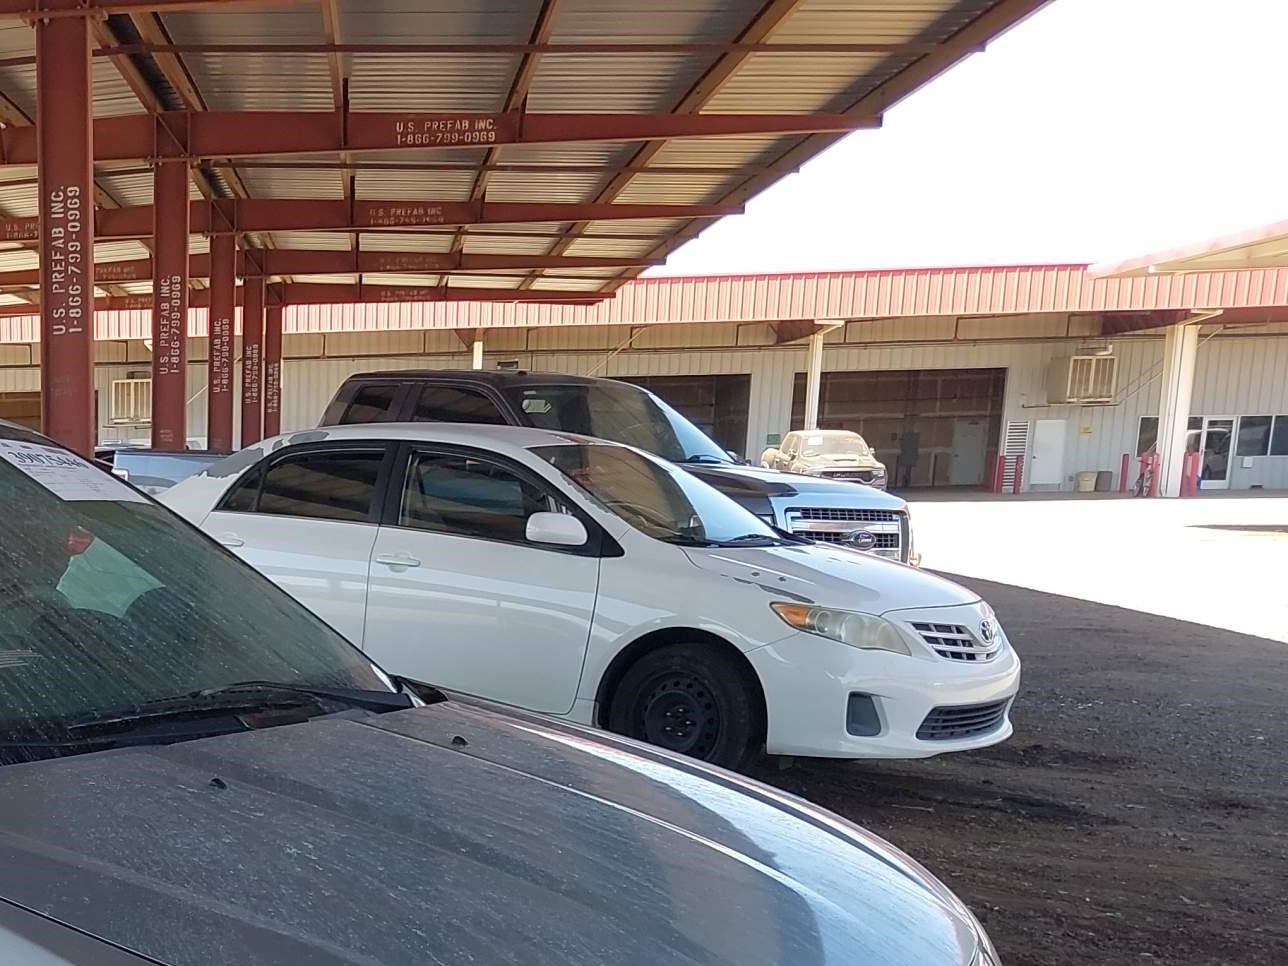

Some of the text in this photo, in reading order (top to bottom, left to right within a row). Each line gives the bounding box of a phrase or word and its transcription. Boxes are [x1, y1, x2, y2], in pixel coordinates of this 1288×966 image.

[396, 118, 497, 133] U.S. PREFAB INC.
[396, 131, 496, 145] 1-866-799-0969
[50, 185, 66, 335] U.S. PREFAB INC.
[66, 186, 83, 333] 1-866-799-0969
[159, 275, 171, 375] U.S. PREFAB INC.
[170, 275, 182, 373] 1-866-799-0969
